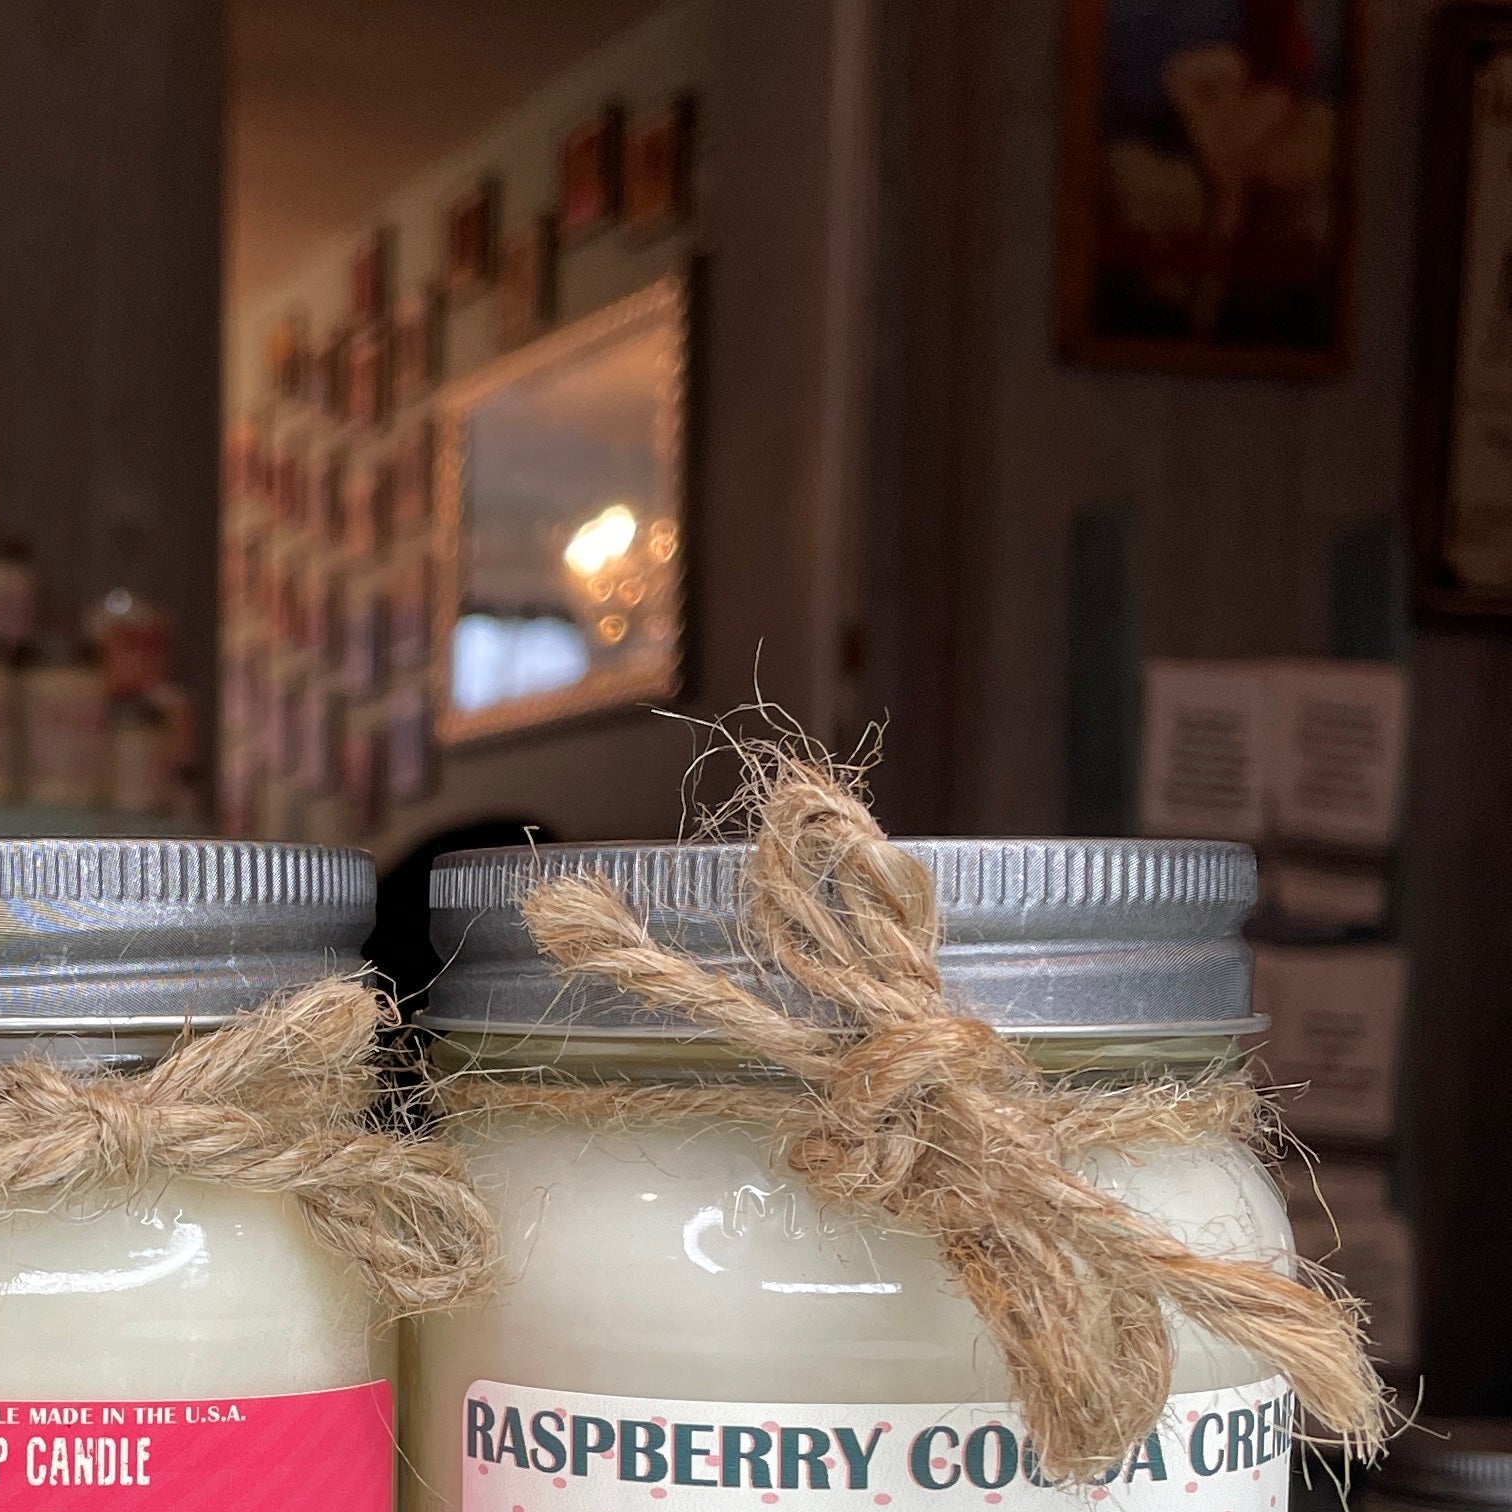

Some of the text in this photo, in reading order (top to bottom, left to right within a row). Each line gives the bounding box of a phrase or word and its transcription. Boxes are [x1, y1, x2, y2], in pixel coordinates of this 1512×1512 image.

[29, 1407, 94, 1426] MADE
[102, 1407, 126, 1426] IN
[133, 1405, 177, 1425] THE
[185, 1403, 246, 1424] U.S.A.
[26, 1436, 152, 1487] CANDLE
[467, 1398, 883, 1491] RASPBERRY
[907, 1424, 1168, 1490] COA
